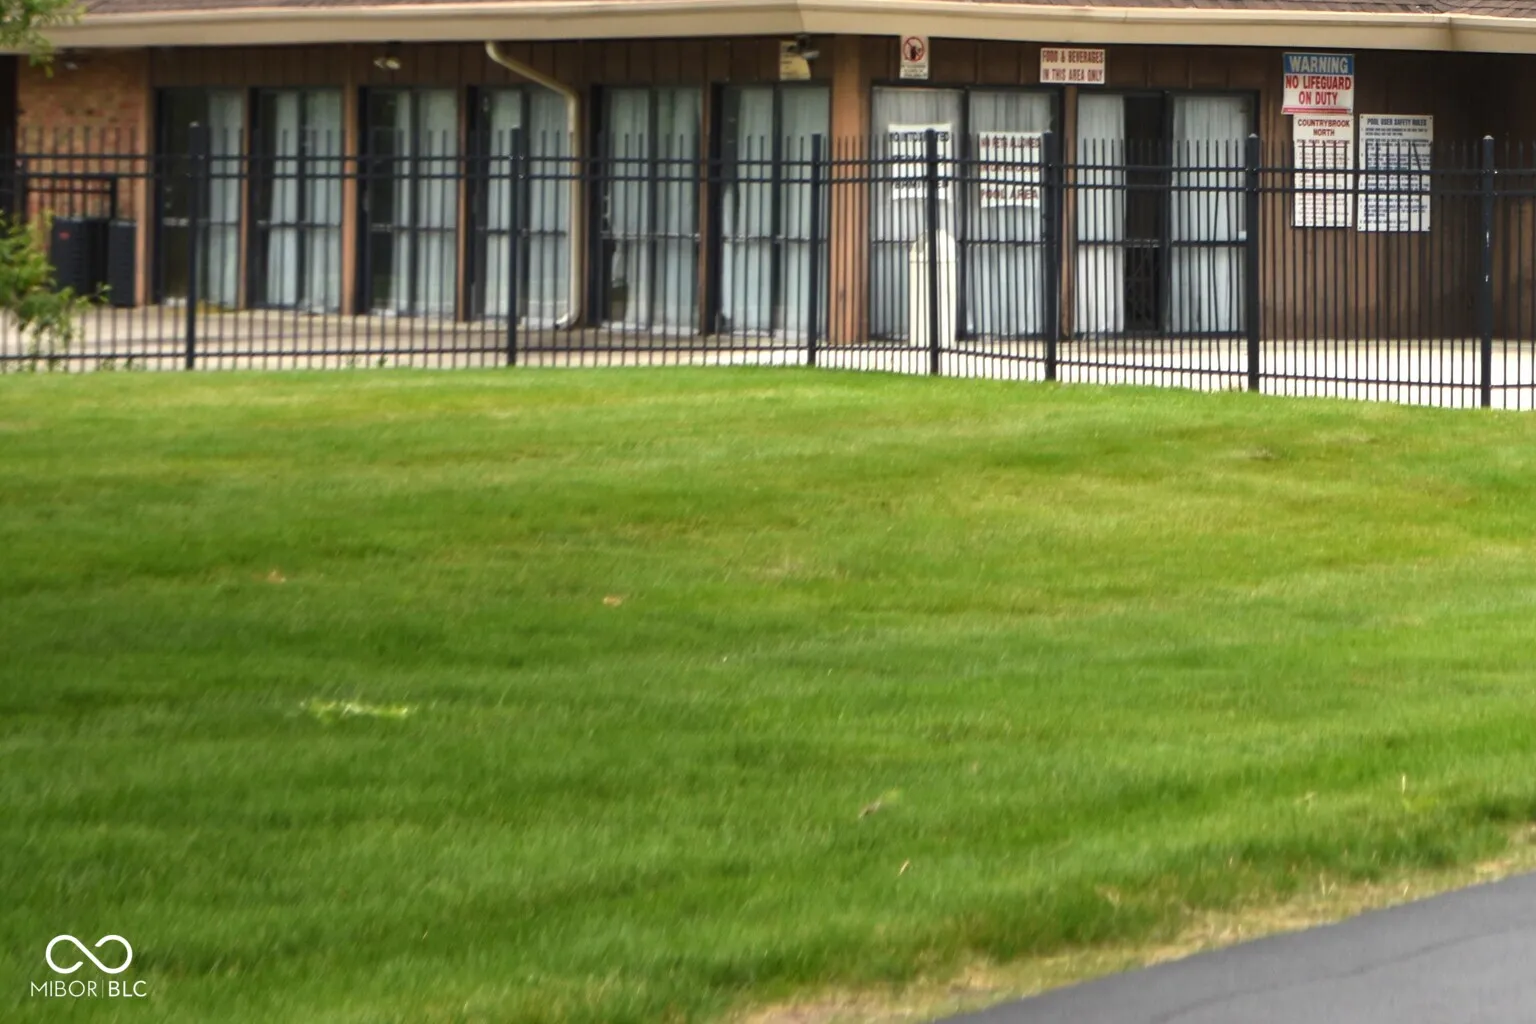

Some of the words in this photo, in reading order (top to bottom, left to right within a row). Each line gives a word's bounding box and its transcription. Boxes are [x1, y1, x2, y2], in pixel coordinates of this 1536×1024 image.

[1068, 50, 1103, 64] BEVERAGES
[1289, 56, 1349, 74] WARNING
[1052, 68, 1066, 81] THIS
[1068, 69, 1084, 82] AREA
[1087, 69, 1103, 82] ONLY
[1285, 75, 1299, 89] NO
[1303, 76, 1352, 90] LIFEGUARD
[1299, 91, 1312, 105] ON
[1315, 91, 1338, 105] DUTY
[1298, 119, 1350, 127] COUNTRYBROOK
[1313, 128, 1335, 136] NORTH
